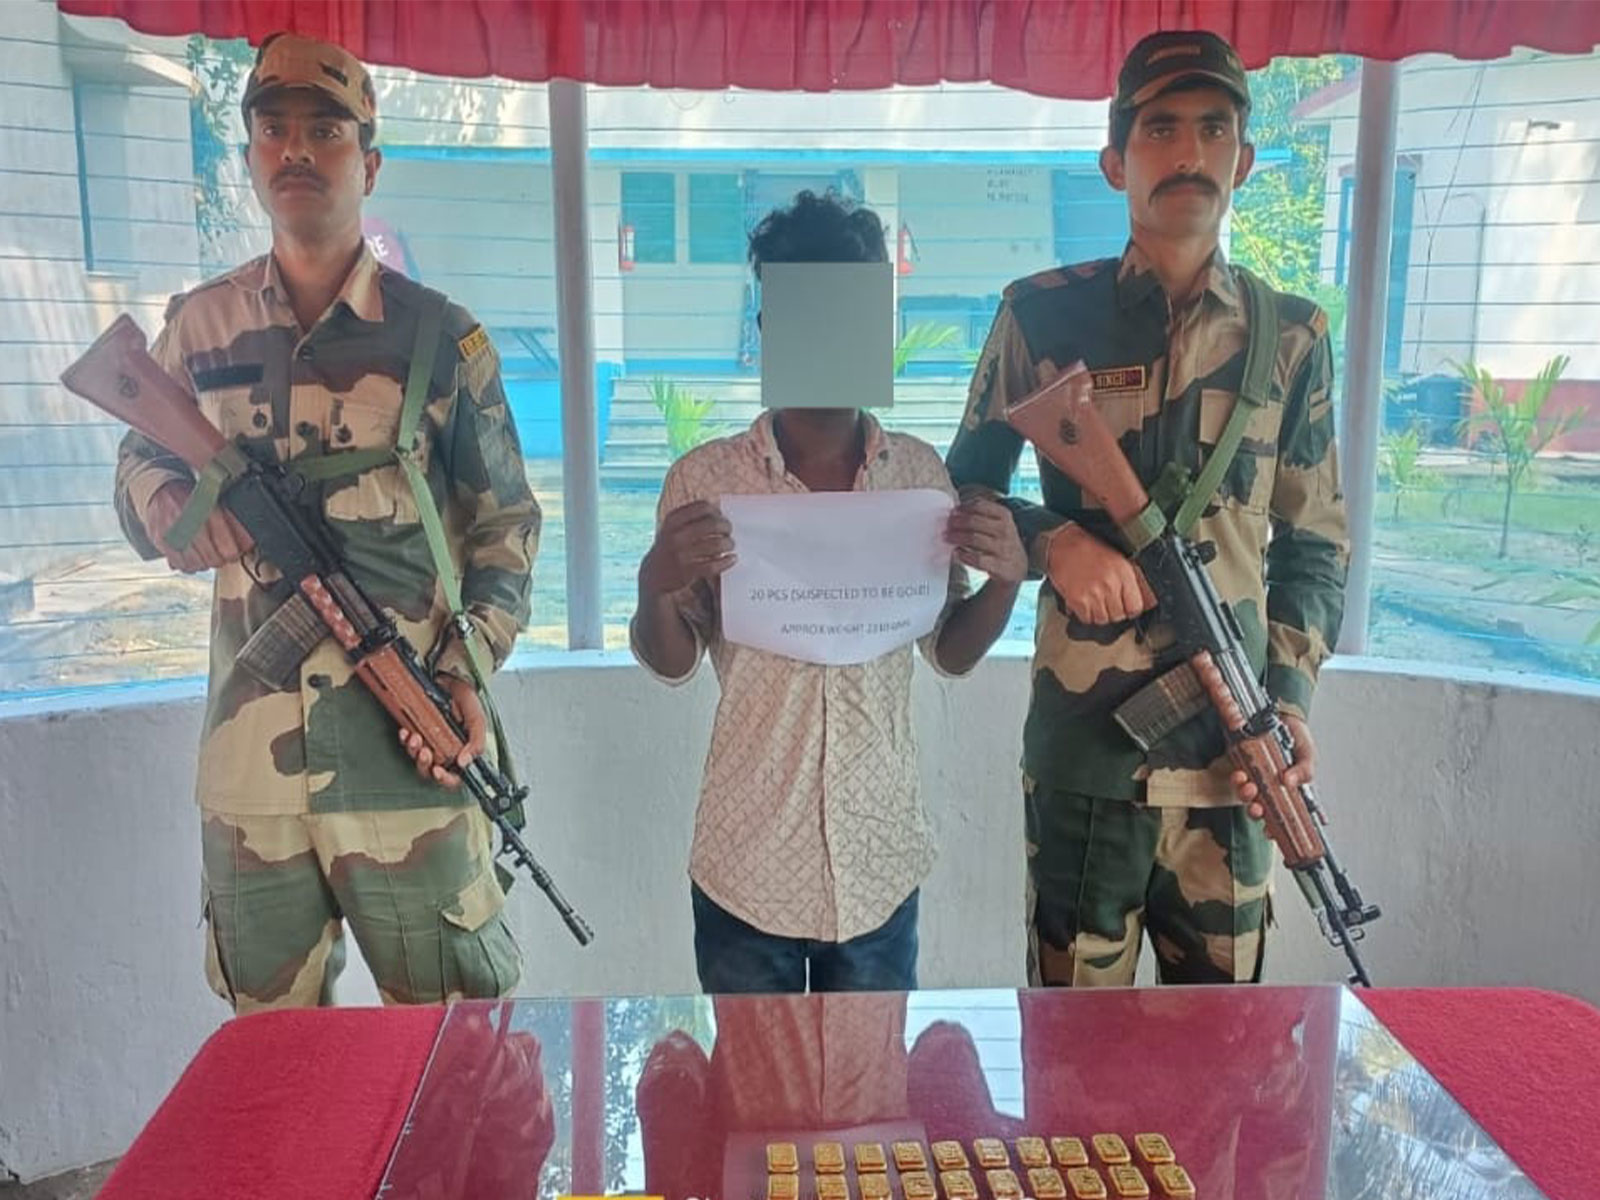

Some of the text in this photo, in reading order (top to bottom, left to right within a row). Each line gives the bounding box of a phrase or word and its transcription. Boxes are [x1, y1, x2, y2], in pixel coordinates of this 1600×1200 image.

[749, 588, 765, 601] 20
[767, 587, 789, 601] PCS
[790, 586, 860, 602] (SUSPECTED
[862, 586, 879, 599] TO
[881, 584, 895, 598] BE
